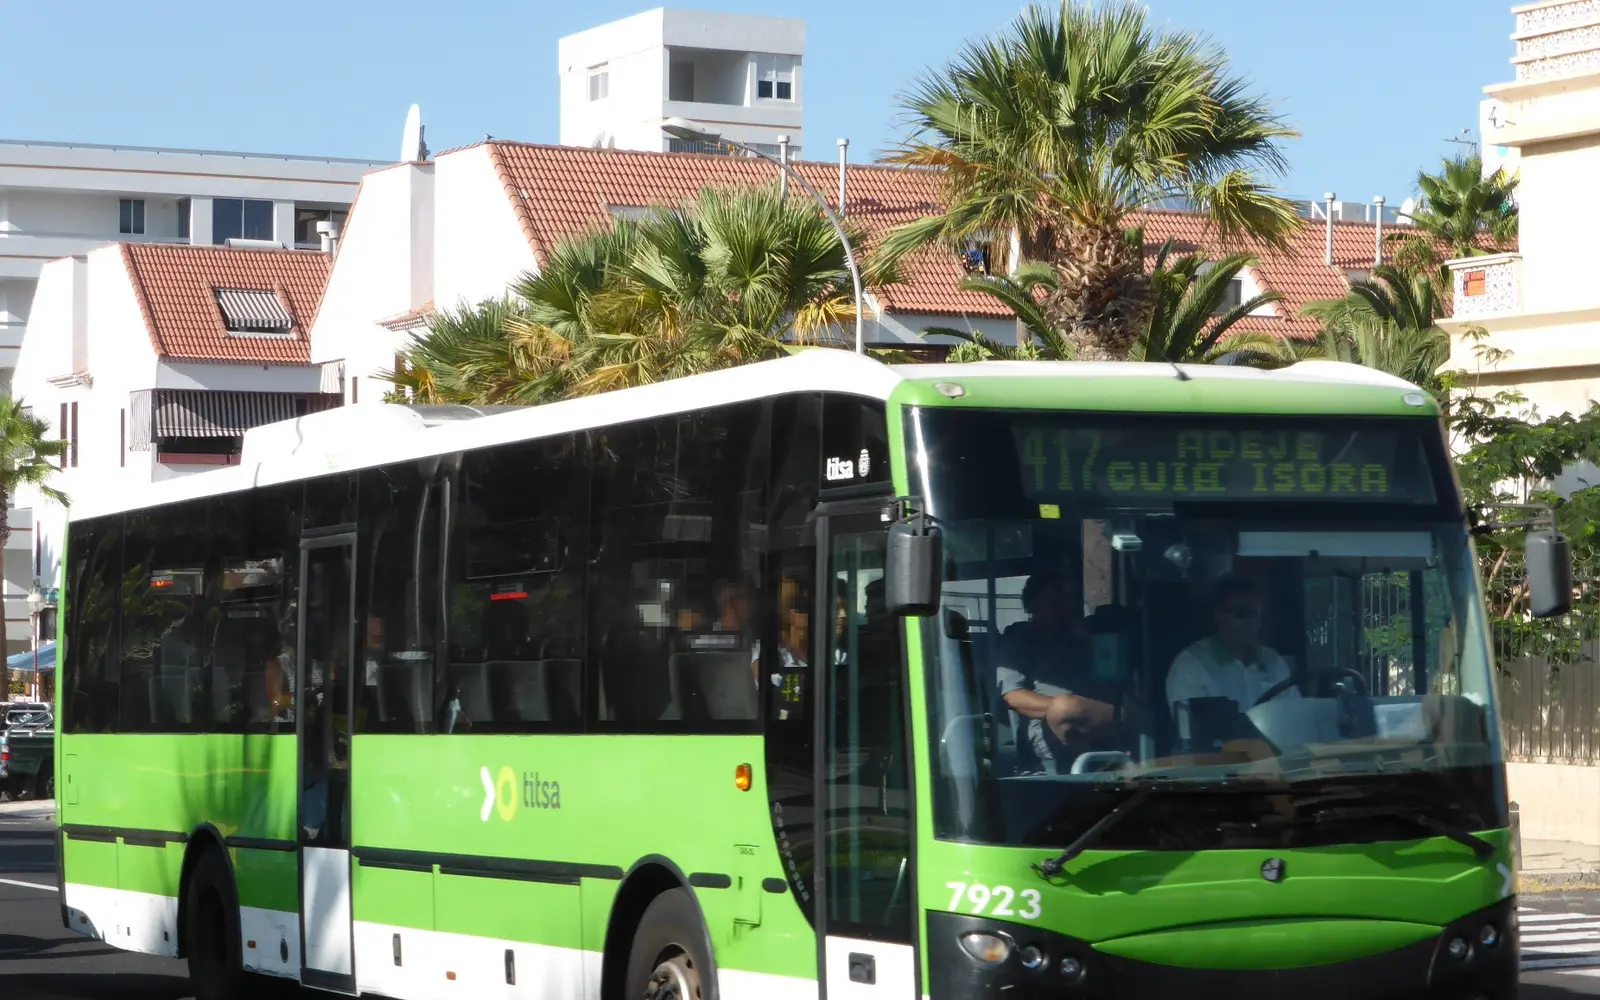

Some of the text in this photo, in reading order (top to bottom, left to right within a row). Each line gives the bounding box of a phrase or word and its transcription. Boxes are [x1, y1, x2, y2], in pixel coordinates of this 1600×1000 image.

[1023, 429, 1100, 491] 417
[1177, 430, 1319, 460] ADEJE
[1252, 463, 1387, 493] ISORA
[523, 771, 561, 809] titsa
[945, 881, 1041, 919] 7923
